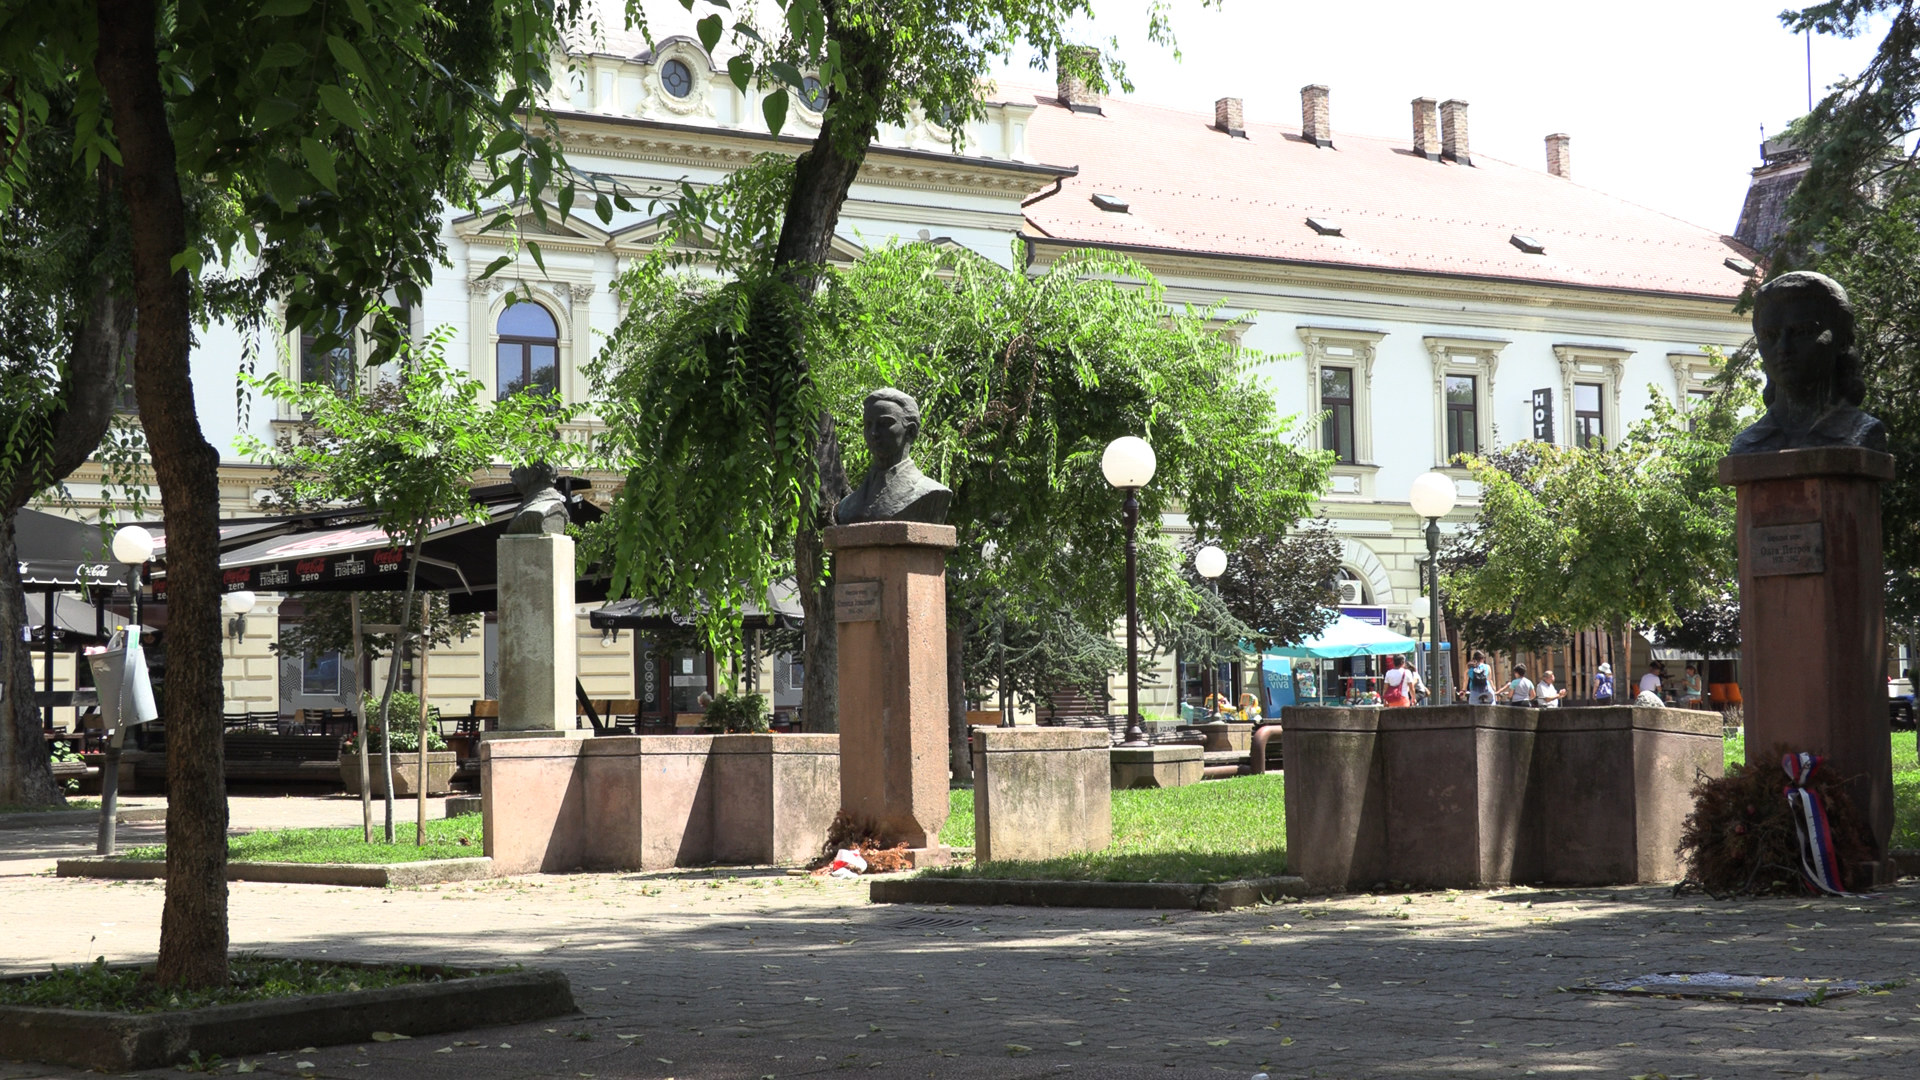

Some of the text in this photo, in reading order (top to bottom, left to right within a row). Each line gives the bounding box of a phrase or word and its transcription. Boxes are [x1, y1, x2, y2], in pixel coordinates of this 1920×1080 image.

[1534, 393, 1545, 442] HOT
[379, 563, 398, 572] zero
[301, 573, 319, 582] zero
[228, 582, 245, 591] zero
[1268, 673, 1289, 683] aqua
[1270, 680, 1290, 689] viva
